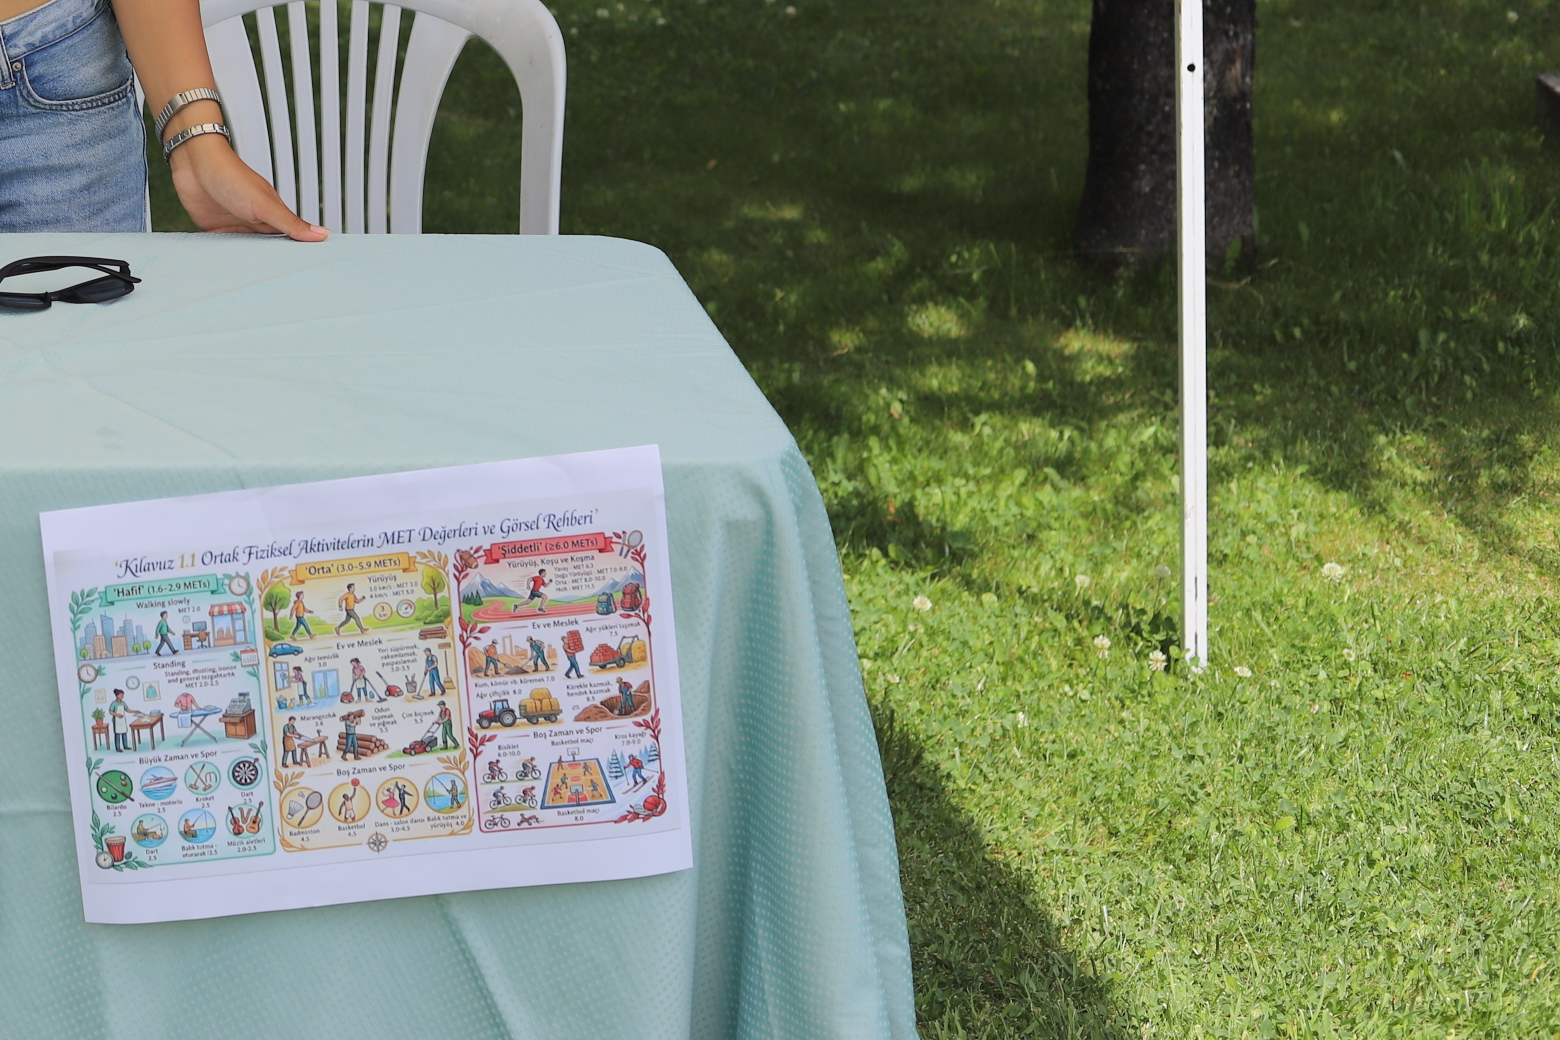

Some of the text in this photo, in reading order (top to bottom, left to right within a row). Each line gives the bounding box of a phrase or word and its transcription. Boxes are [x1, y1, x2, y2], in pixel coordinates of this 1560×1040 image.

[179, 553, 196, 570] 1.1
[201, 546, 240, 566] Ortak
[242, 541, 292, 565] Fiziksel
[292, 531, 374, 559] Aktivitelerin
[378, 528, 416, 548] MET
[418, 522, 478, 546] Değerleri
[482, 524, 496, 536] ve
[500, 513, 541, 539] Görsel
[545, 540, 568, 553] (≥6.0
[572, 537, 598, 550] METs)
[374, 558, 400, 569] METs)
[507, 560, 540, 570] Yürüyüş,
[541, 558, 560, 566] Koşu
[570, 554, 595, 564] Koşma
[184, 578, 210, 590] METs)
[368, 576, 397, 584] Yürüyüş
[136, 596, 190, 610] Walking slowly
[532, 622, 540, 630] Ev
[552, 618, 580, 628] Meslek
[357, 638, 383, 648] Meslek
[153, 660, 186, 670] Standing
[533, 730, 548, 740] Boş
[549, 728, 575, 738] Zaman
[586, 726, 603, 736] Spor
[138, 756, 162, 766] Büyük
[164, 754, 190, 763] Zaman
[200, 750, 218, 760] Spor
[336, 768, 350, 778] Boş
[351, 766, 378, 774] Zaman
[388, 762, 406, 774] Spor
